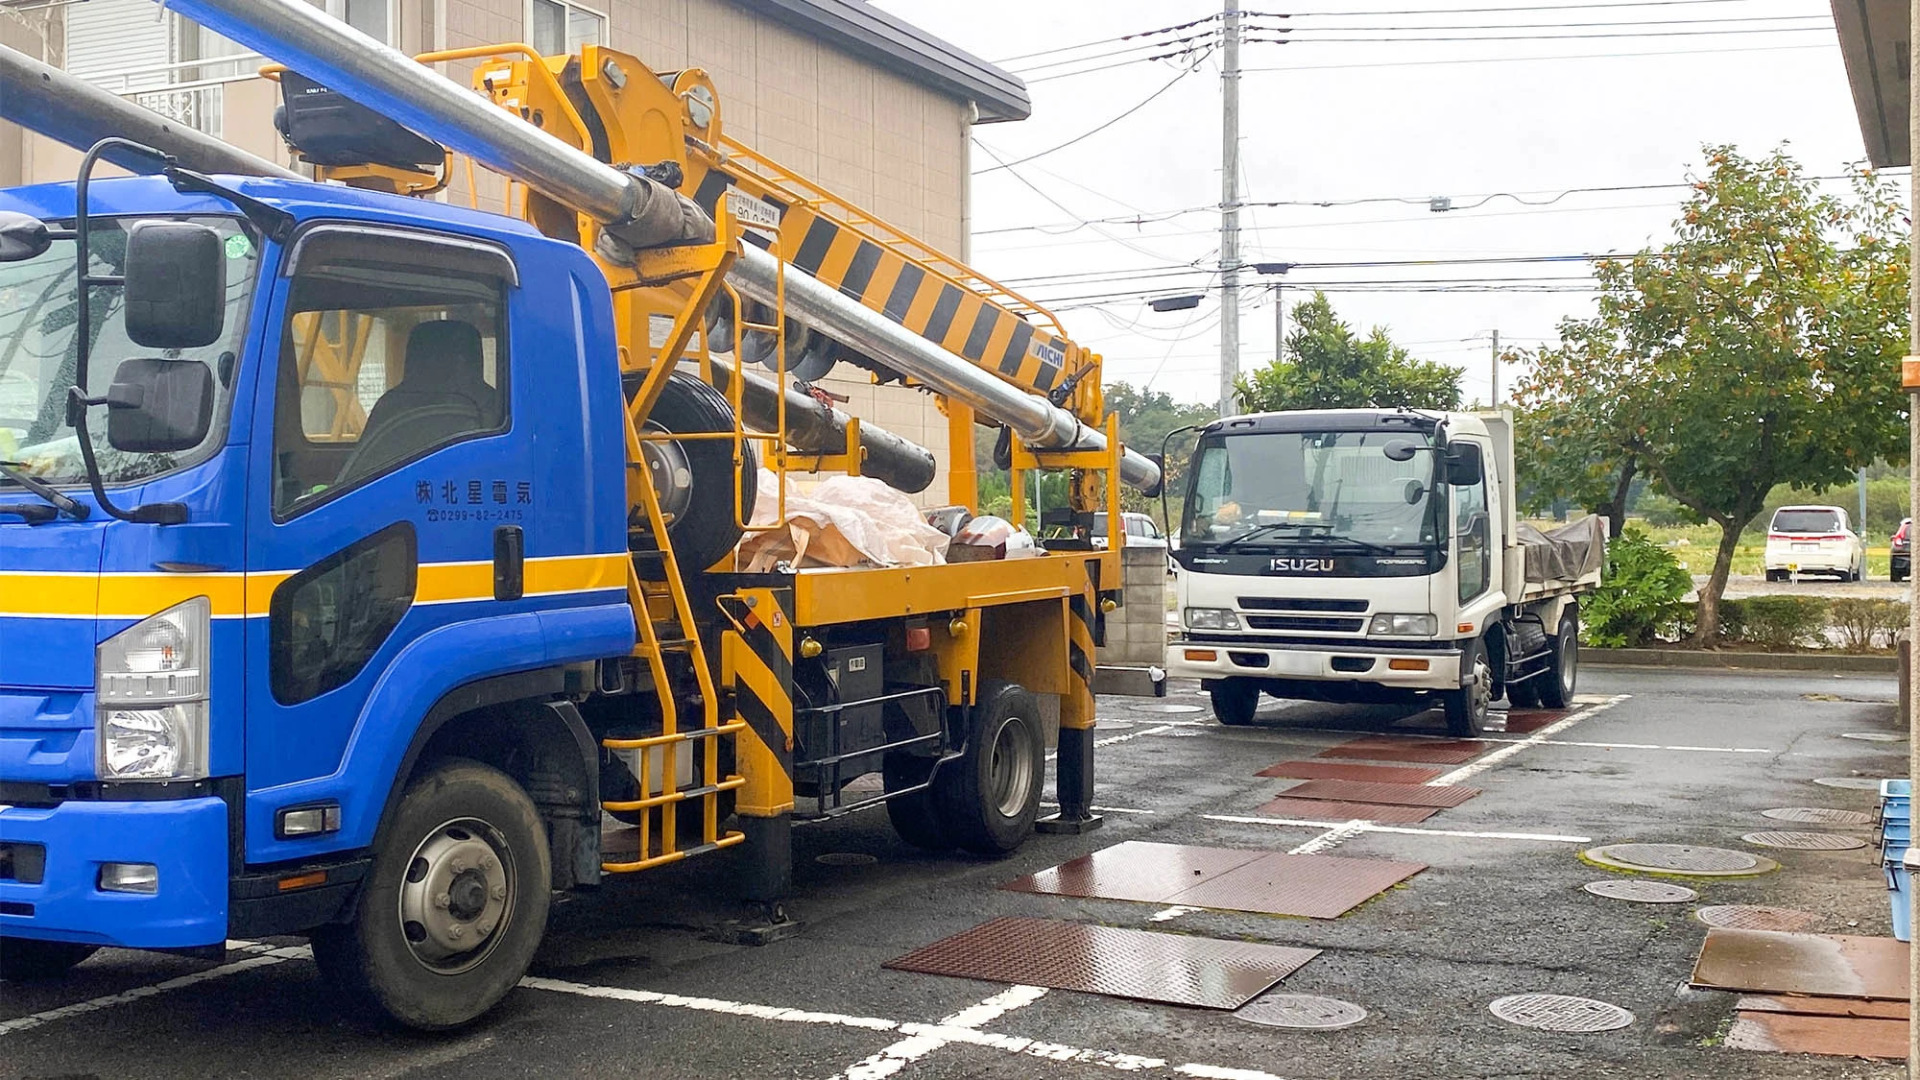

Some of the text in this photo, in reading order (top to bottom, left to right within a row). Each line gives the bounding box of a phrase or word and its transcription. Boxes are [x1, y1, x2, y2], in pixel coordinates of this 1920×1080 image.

[1036, 344, 1063, 368] AICHI
[440, 509, 523, 521] 0299-82-2475
[1270, 558, 1334, 571] ISUZU
